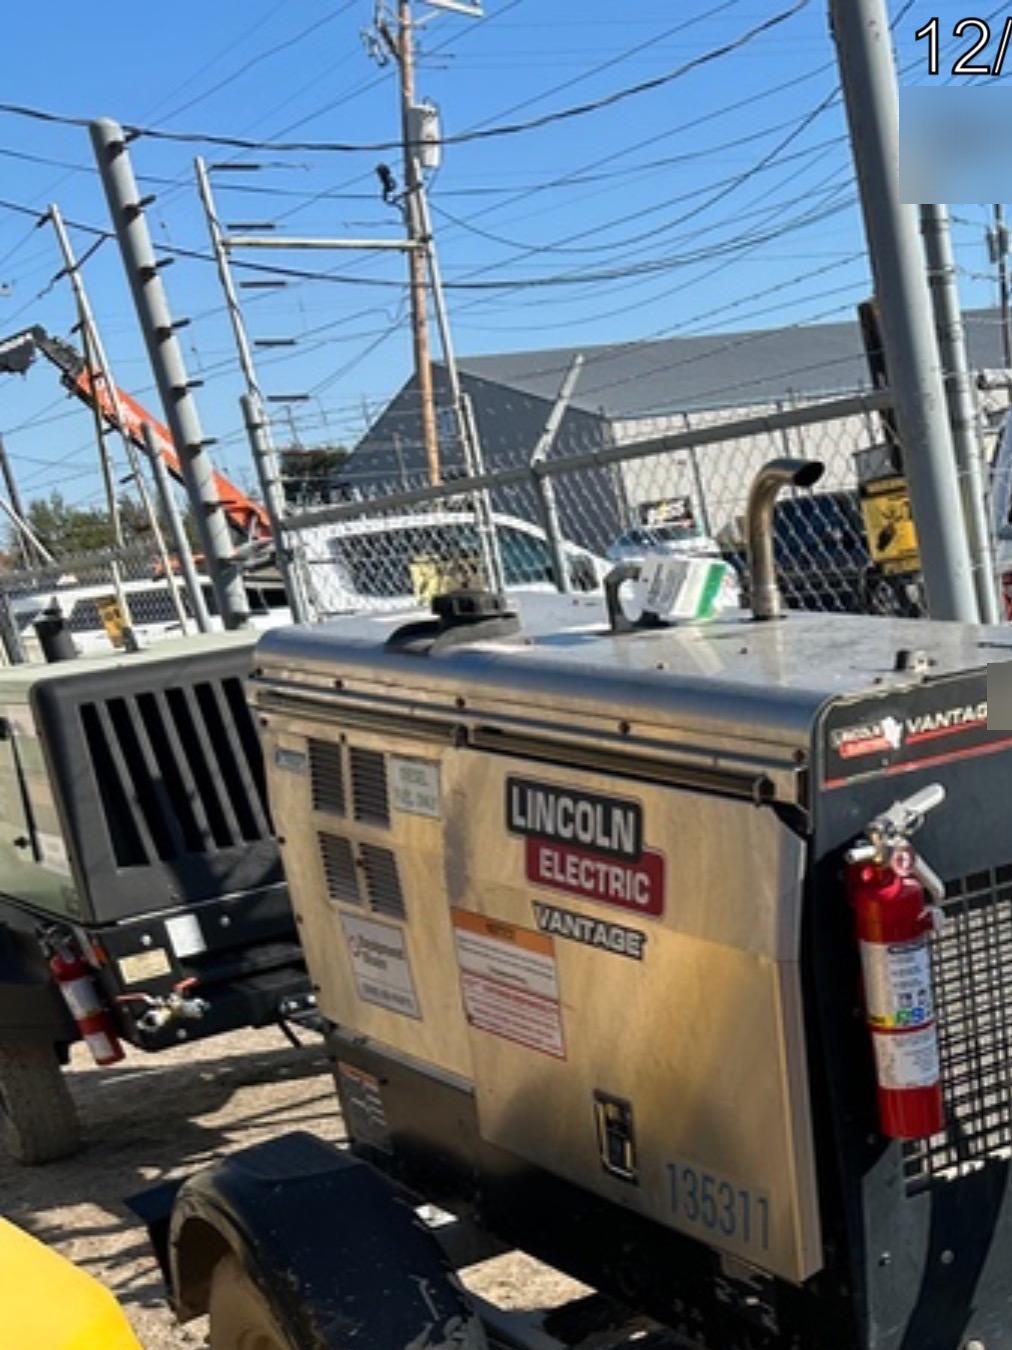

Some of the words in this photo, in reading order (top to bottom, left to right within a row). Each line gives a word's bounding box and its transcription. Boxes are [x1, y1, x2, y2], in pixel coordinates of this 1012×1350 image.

[905, 702, 988, 734] VANTAG
[511, 784, 636, 855] LINCOLN
[538, 847, 650, 905] ELECTRIC
[533, 902, 642, 958] VANTAGE
[665, 1162, 769, 1251] 135311
